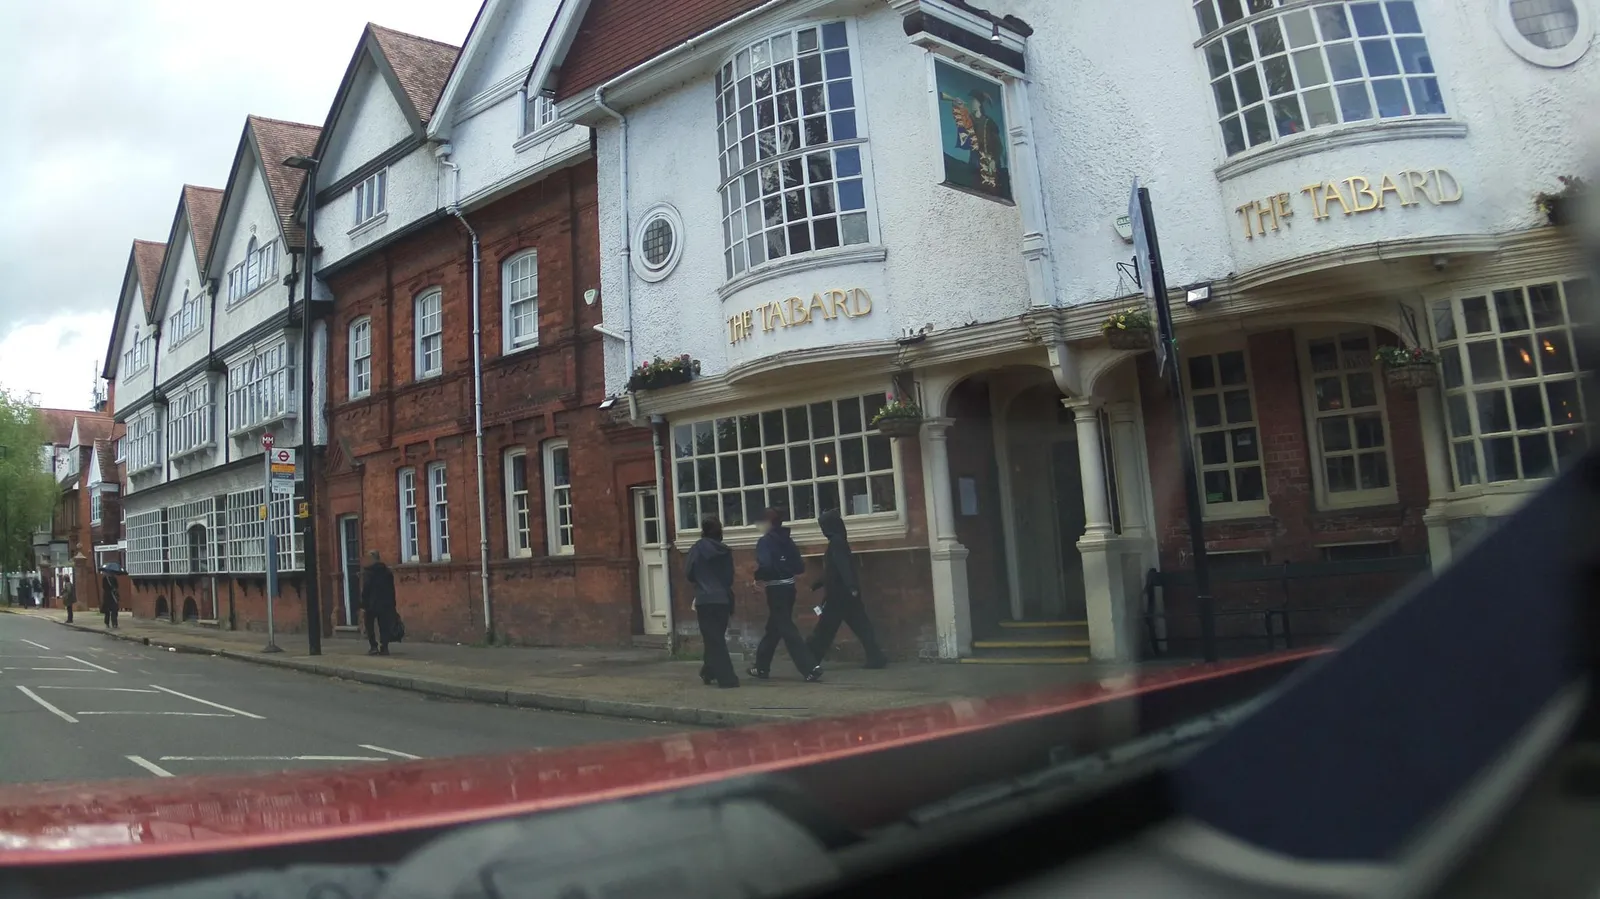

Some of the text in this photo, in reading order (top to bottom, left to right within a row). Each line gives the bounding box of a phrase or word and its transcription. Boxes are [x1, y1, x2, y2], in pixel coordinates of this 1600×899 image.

[1236, 168, 1464, 239] THE TABARD
[727, 287, 873, 345] THE TABARD
